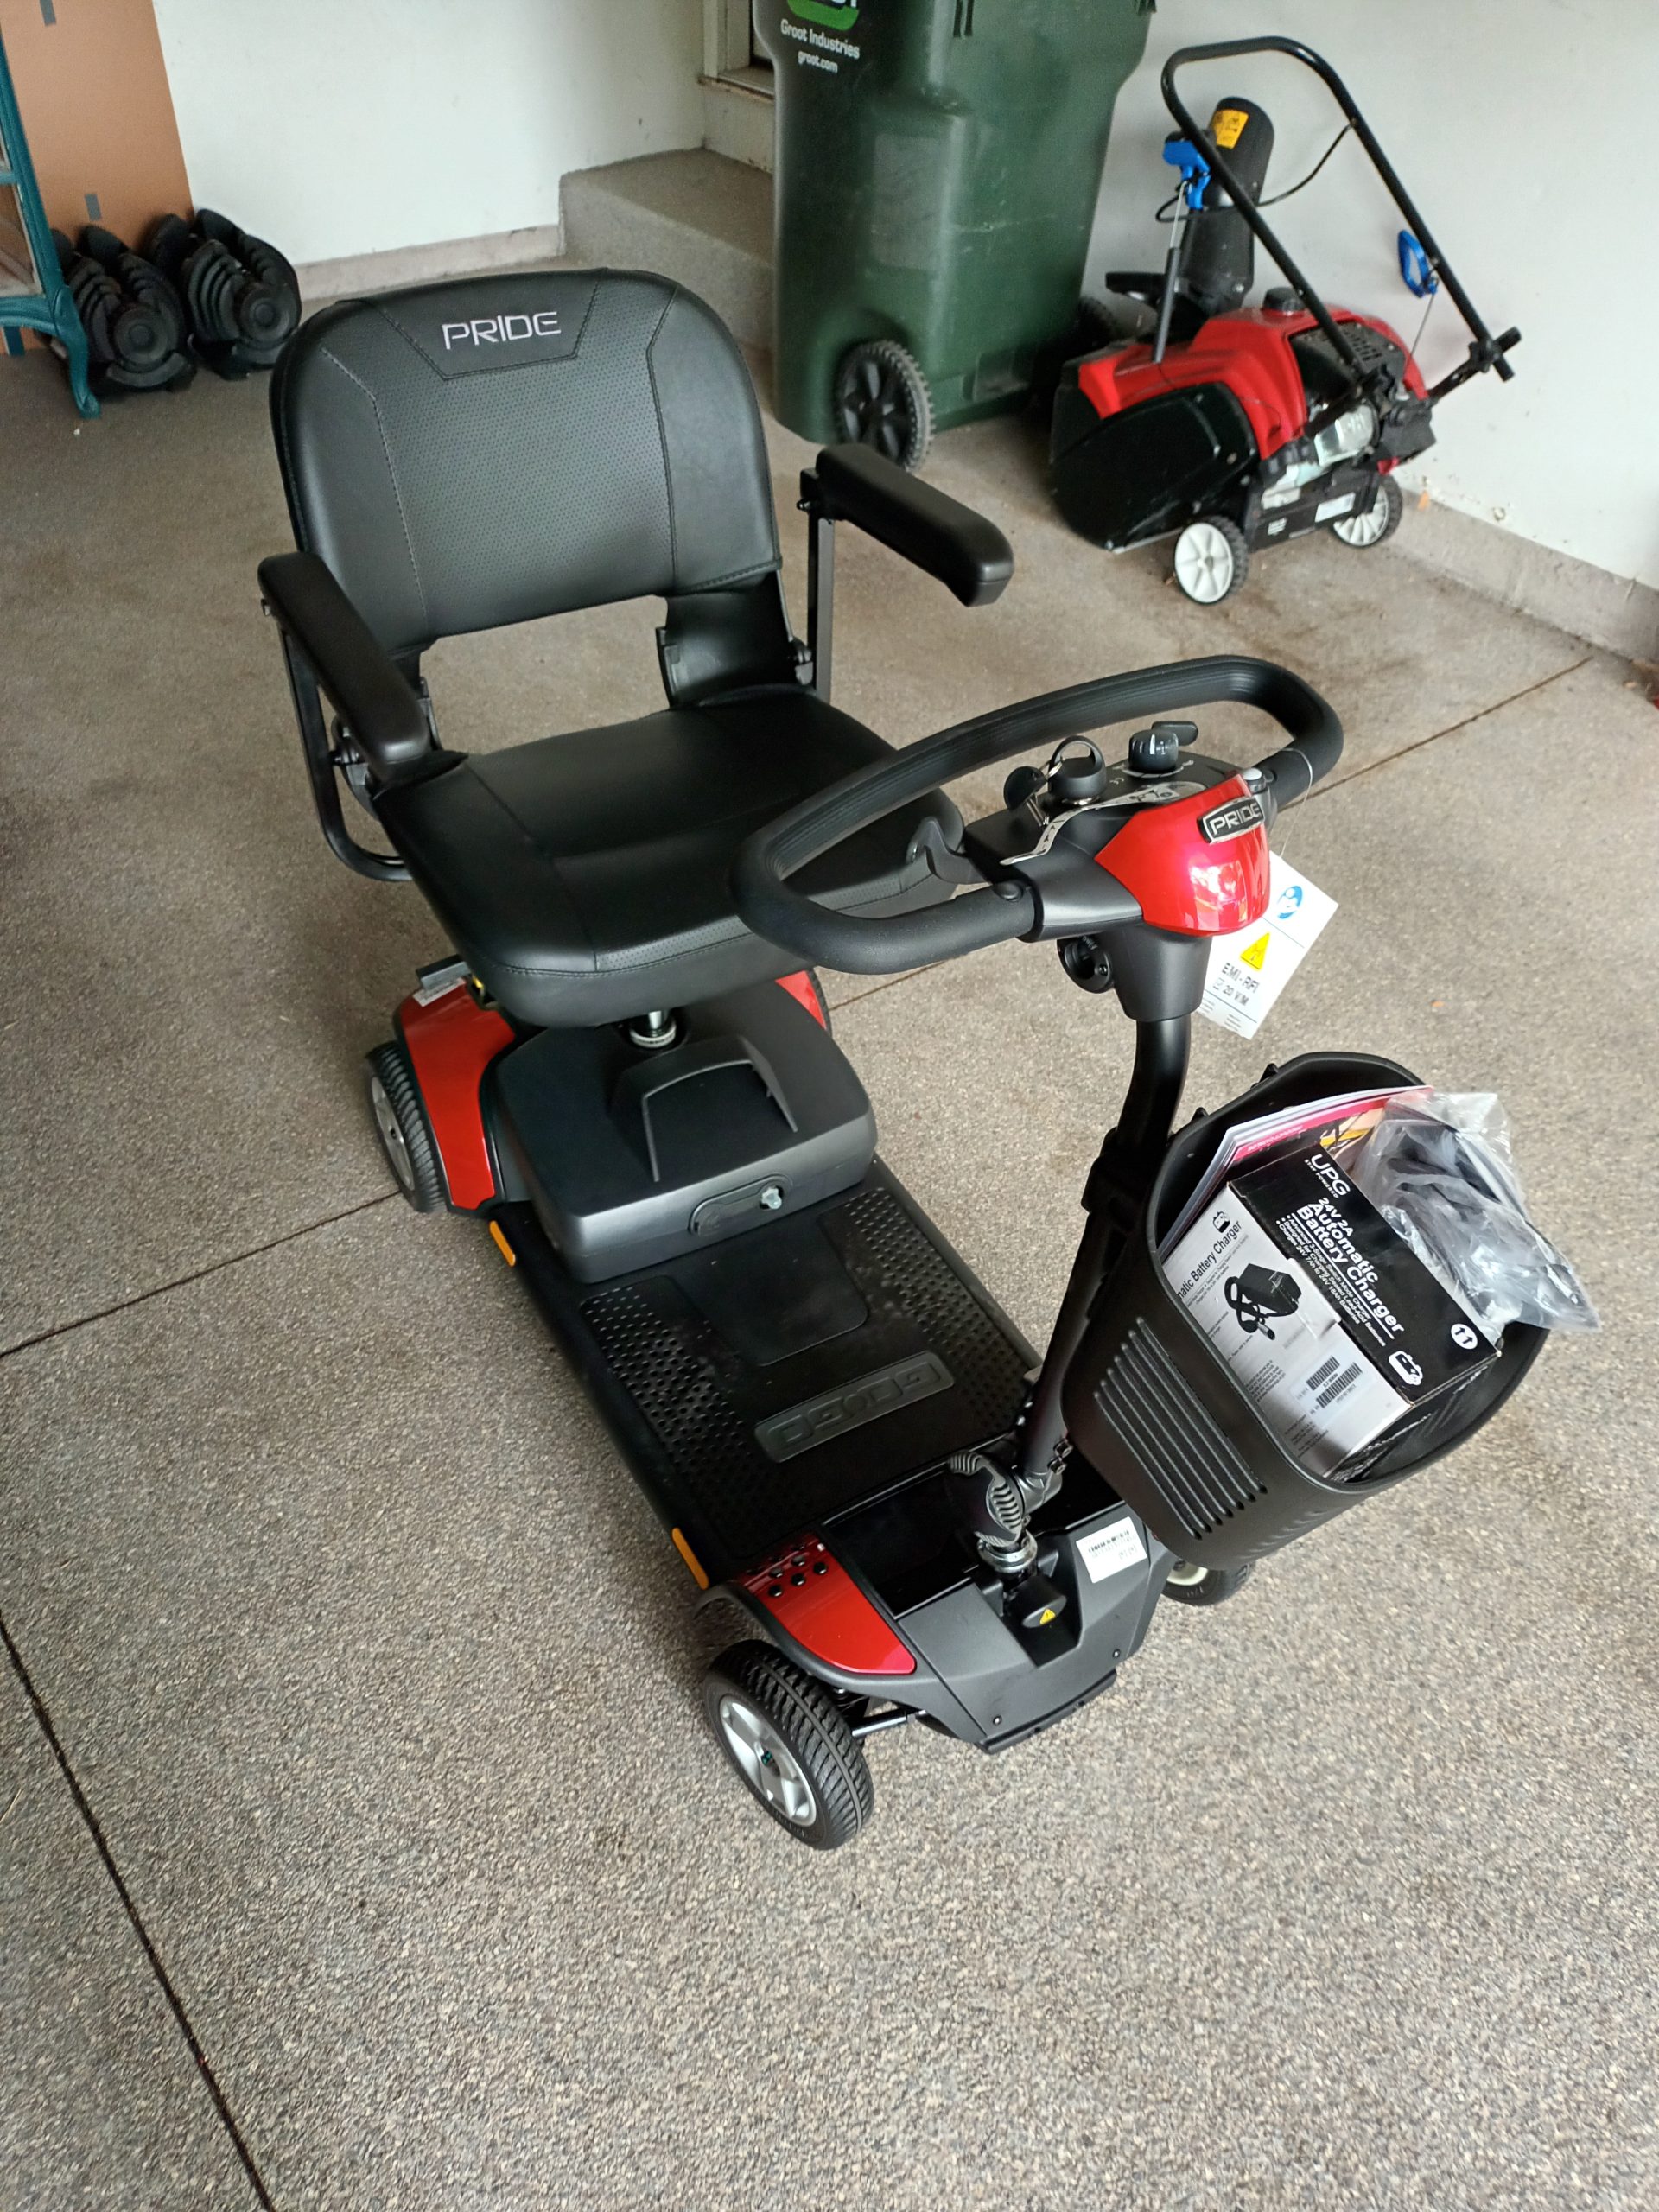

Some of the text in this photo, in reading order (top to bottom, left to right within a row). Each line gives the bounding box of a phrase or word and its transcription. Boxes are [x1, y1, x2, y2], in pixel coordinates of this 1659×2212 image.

[781, 19, 860, 59] Groot Industries
[798, 51, 838, 73] groot.com
[442, 311, 562, 350] PRIDE
[1210, 803, 1262, 836] PRIDE
[1311, 1154, 1351, 1196] UPG
[1318, 1197, 1354, 1237] 24V 2A
[1190, 1251, 1217, 1282] Battery
[1212, 1220, 1242, 1255] Charger
[1305, 1204, 1379, 1283] Automatic
[1293, 1205, 1349, 1263] Battery
[1339, 1266, 1405, 1332] Charger
[1352, 1297, 1372, 1319] Charger
